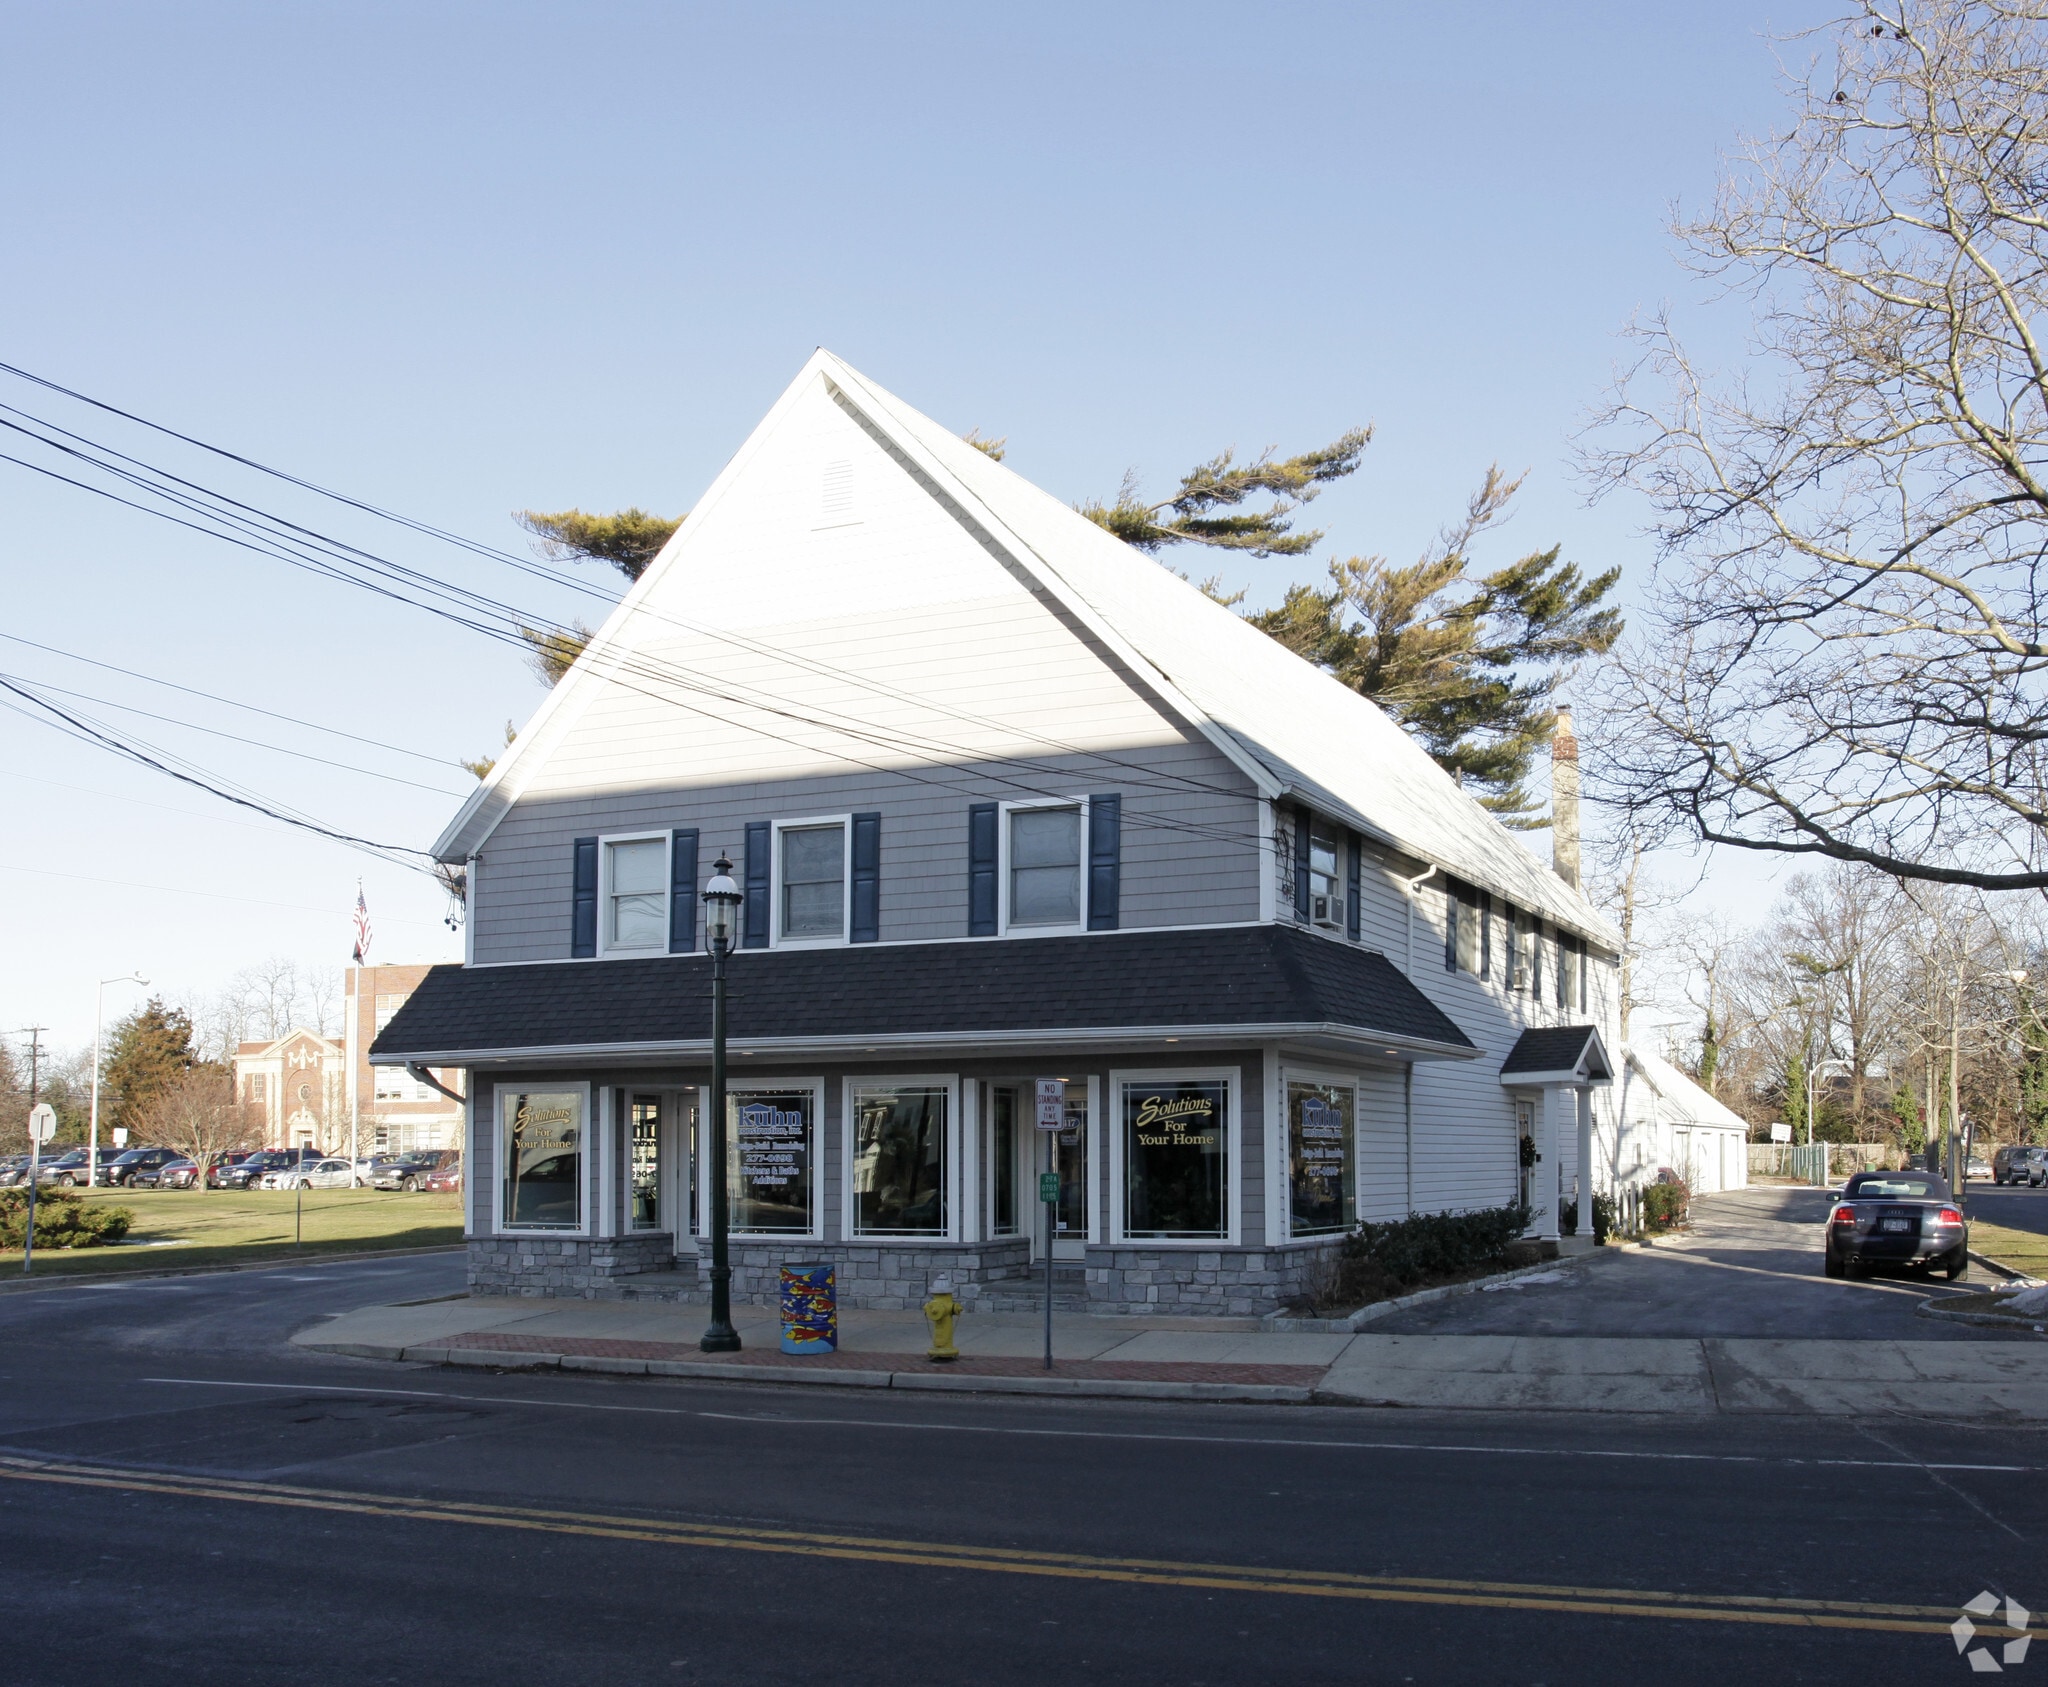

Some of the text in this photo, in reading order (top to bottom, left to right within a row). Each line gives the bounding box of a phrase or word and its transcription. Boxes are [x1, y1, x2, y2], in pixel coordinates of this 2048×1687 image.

[1044, 1084, 1056, 1093] NO
[1038, 1095, 1062, 1104] STANDING
[1136, 1095, 1212, 1127] Solutions
[514, 1106, 571, 1133] Solutions
[738, 1126, 803, 1136] construction, inc.
[1164, 1120, 1187, 1132] For
[535, 1128, 552, 1137] For
[515, 1139, 572, 1149] Your Home
[1138, 1133, 1214, 1145] Your Home
[745, 1154, 793, 1163] 277-0698
[779, 1166, 800, 1175] Baths
[752, 1175, 788, 1185] Additions
